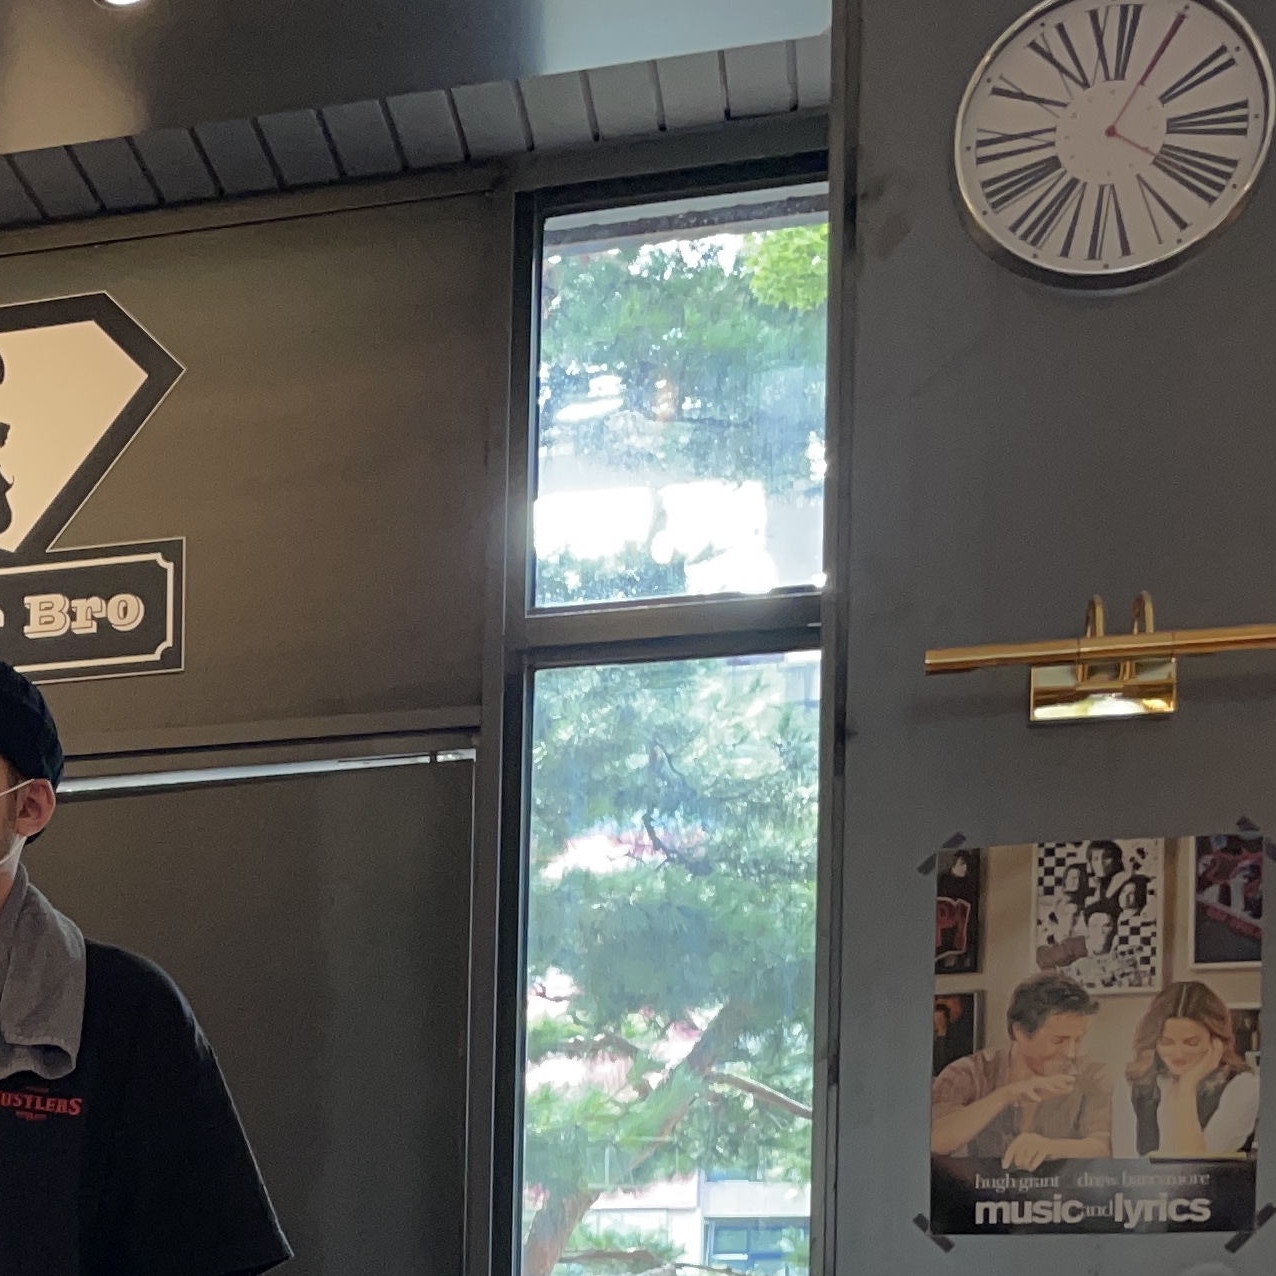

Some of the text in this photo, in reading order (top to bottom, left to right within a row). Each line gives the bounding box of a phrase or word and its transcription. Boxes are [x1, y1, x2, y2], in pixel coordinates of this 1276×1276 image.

[24, 593, 144, 638] Bro
[975, 1173, 1017, 1193] hugh
[975, 1193, 1083, 1225] music
[1113, 1192, 1212, 1229] lyrics
